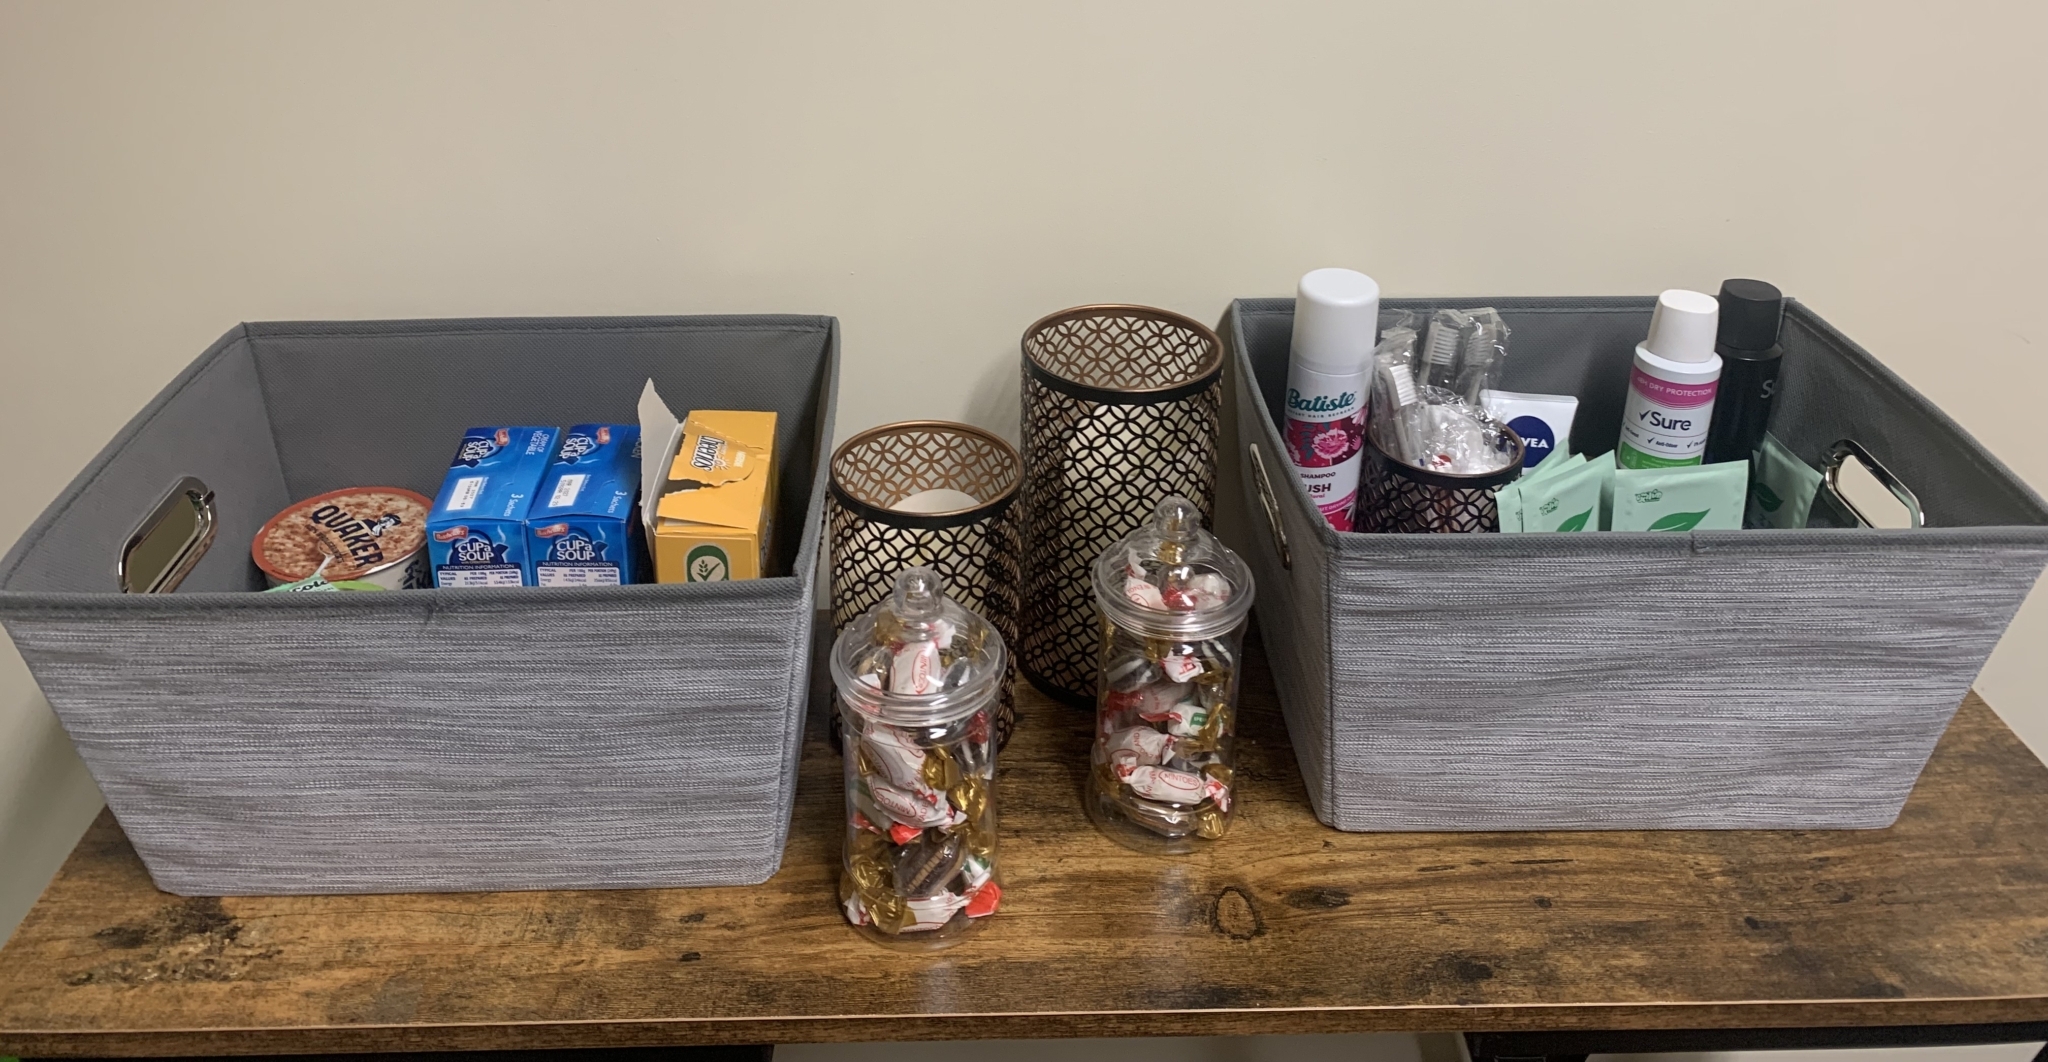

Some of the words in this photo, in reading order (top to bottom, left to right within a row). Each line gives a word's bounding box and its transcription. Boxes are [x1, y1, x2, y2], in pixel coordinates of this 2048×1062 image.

[1649, 382, 1664, 392] DRY
[1666, 387, 1712, 397] PROTECTION
[1287, 388, 1357, 412] Batiste
[1649, 411, 1692, 431] Sure
[462, 441, 477, 461] SOUP
[525, 430, 543, 455] VEGETABLE
[559, 438, 577, 459] SOUP
[1520, 437, 1549, 449] VEA
[503, 498, 518, 517] Sachets
[607, 495, 622, 514] Sachets
[310, 505, 384, 568] QUAKER
[458, 552, 494, 561] SOUP
[556, 550, 596, 561] SOUP
[1164, 773, 1198, 786] MINTOES
